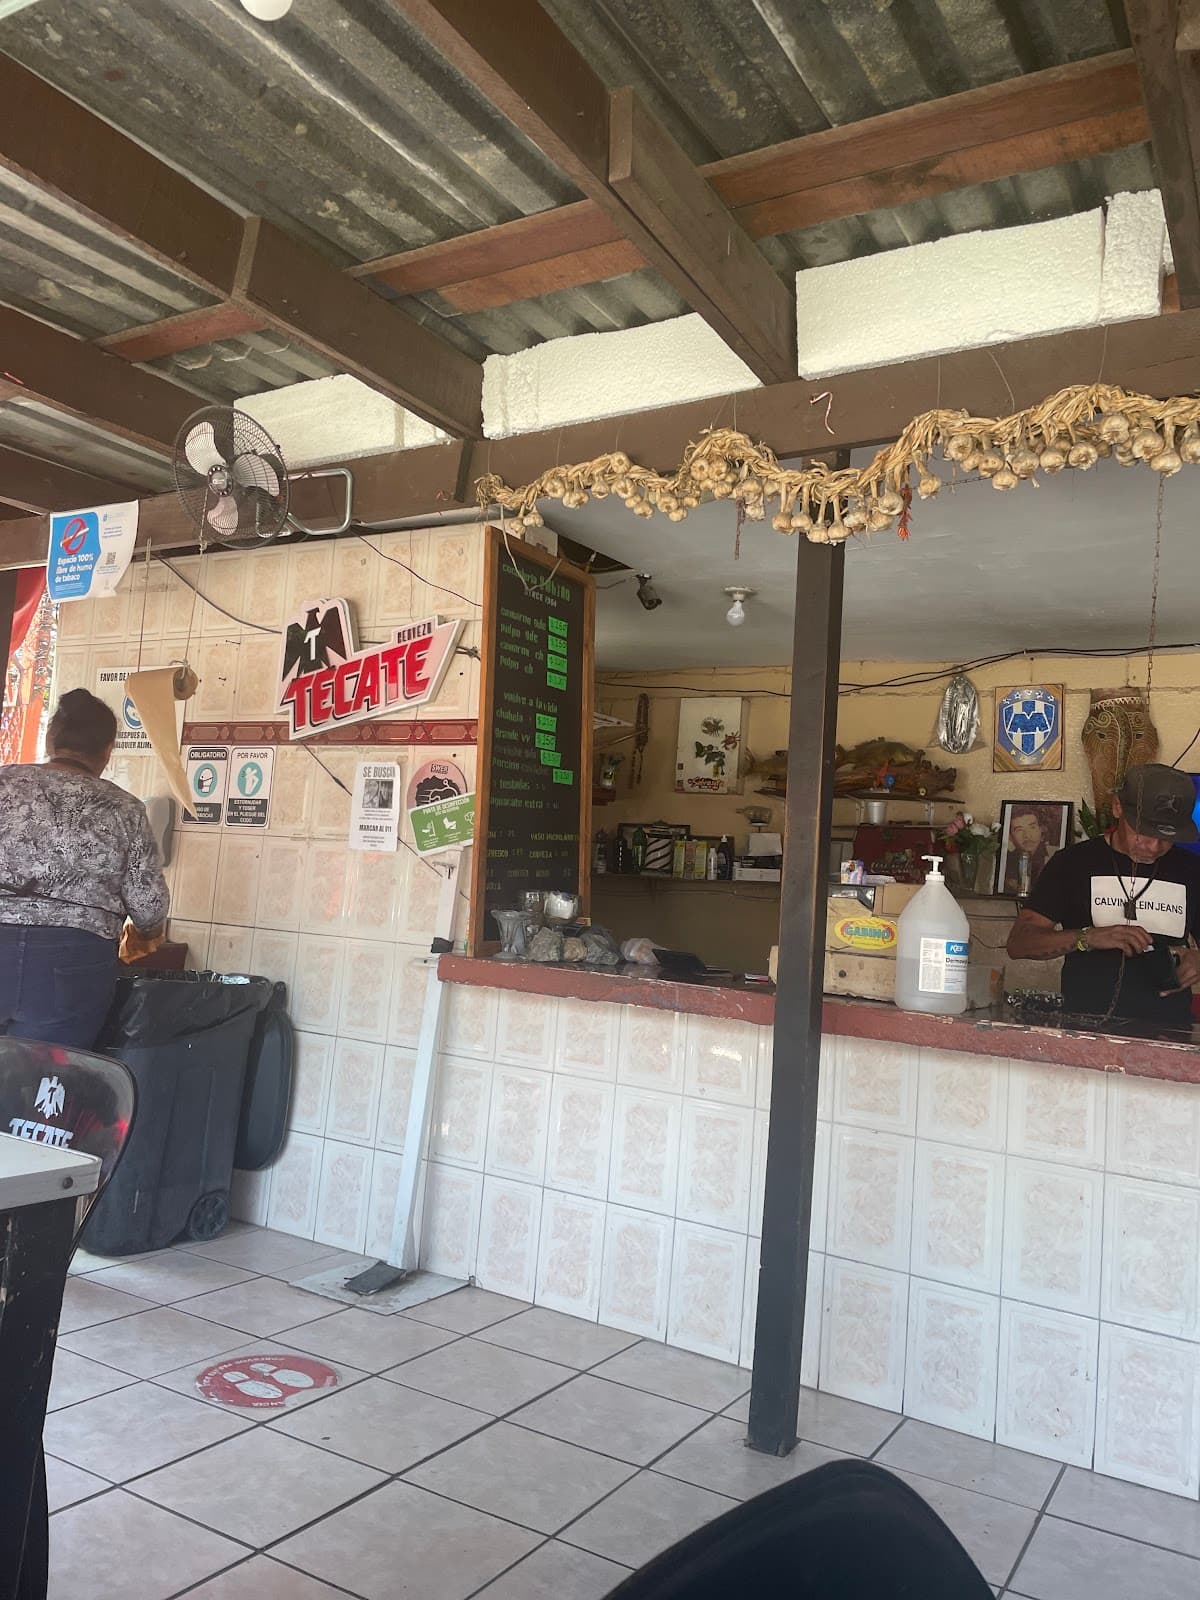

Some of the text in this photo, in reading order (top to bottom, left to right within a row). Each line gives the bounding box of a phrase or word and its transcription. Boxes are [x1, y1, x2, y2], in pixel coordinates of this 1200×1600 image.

[58, 553, 93, 566] Espacio 100%
[77, 563, 92, 572] humo
[55, 573, 80, 583] de tabaco
[397, 622, 432, 644] CERVEZA
[100, 673, 119, 682] FAVOR
[119, 672, 126, 681] DE
[281, 636, 434, 732] TECATE
[190, 751, 226, 759] OBLIGATORIO
[249, 752, 268, 760] FAVOR
[363, 766, 372, 778] SE
[1094, 897, 1127, 907] CALVIN
[1155, 902, 1184, 915] JEANS
[9, 1117, 74, 1149] TECATE
